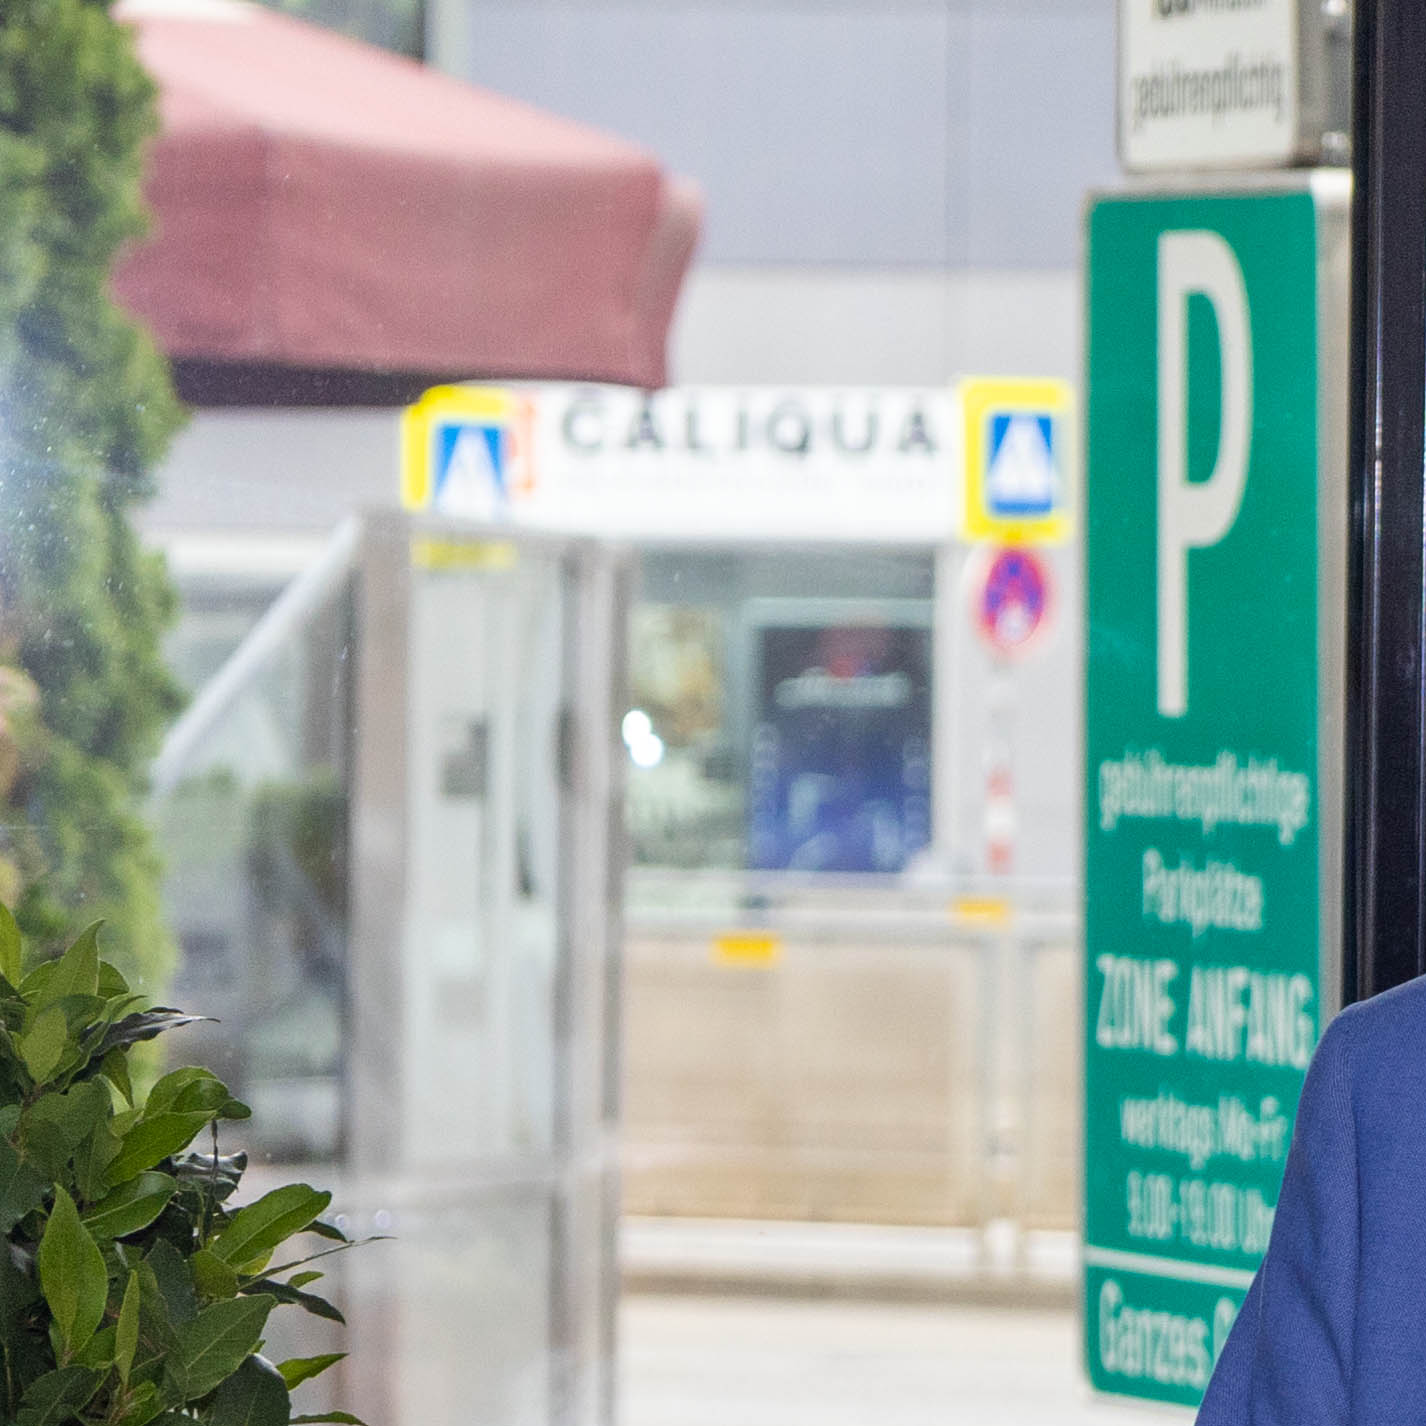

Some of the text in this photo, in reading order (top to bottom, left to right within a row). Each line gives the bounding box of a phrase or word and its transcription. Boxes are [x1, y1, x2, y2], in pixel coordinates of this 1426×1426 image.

[561, 397, 938, 456] CALIQUA
[1157, 229, 1254, 719] P
[1096, 953, 1314, 1070] ZONE ANFANG
[1099, 1277, 1211, 1391] Ganzes
